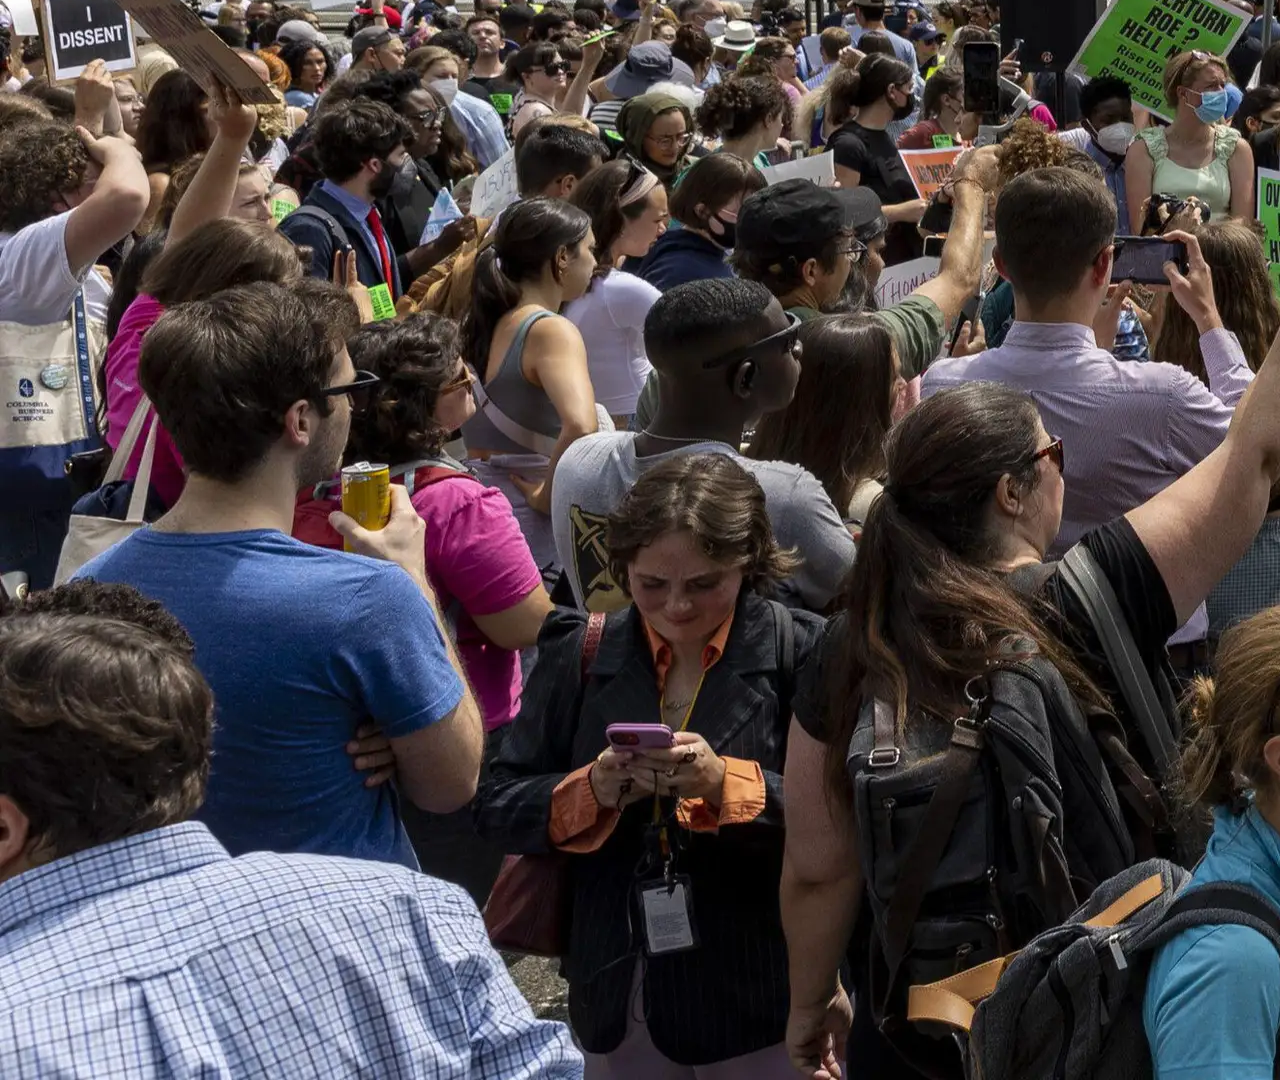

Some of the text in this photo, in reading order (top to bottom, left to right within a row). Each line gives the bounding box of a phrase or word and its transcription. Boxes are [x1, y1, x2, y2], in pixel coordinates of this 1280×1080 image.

[86, 6, 92, 22] I
[1145, 5, 1184, 39] ROE
[59, 24, 124, 50] DISSENT
[1119, 18, 1163, 54] HELL
[1110, 57, 1163, 91] Abortion
[1116, 44, 1164, 75] Rise Up
